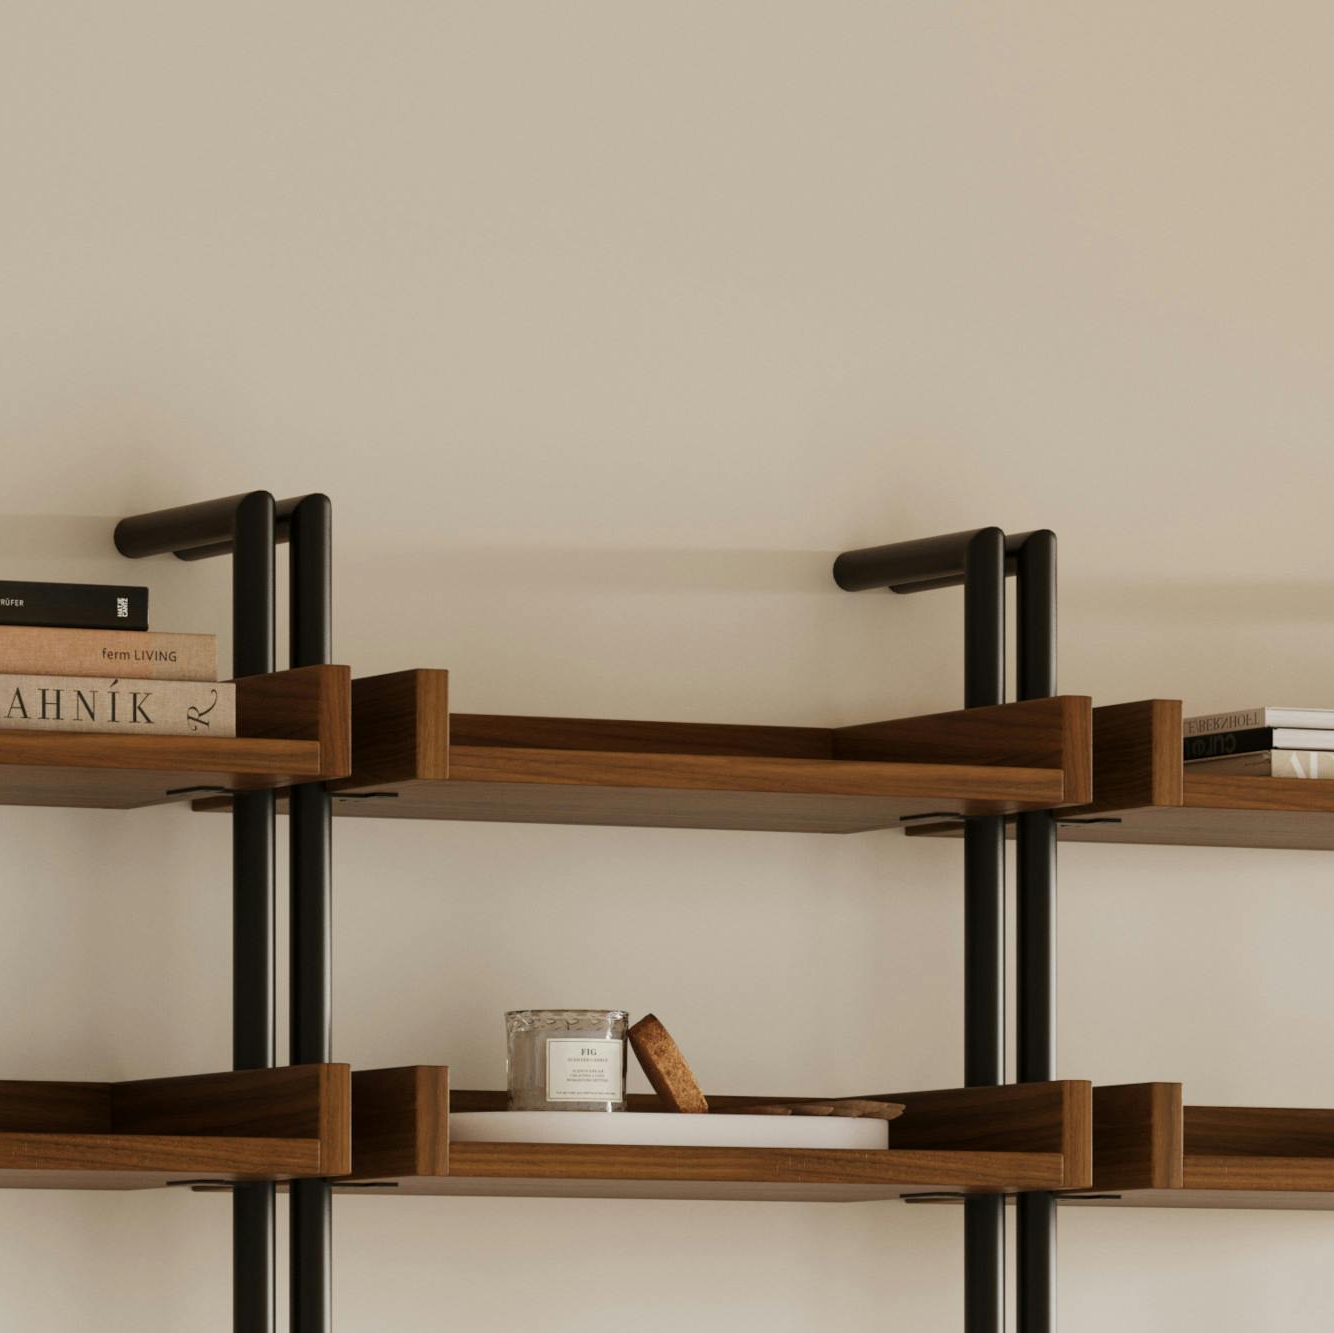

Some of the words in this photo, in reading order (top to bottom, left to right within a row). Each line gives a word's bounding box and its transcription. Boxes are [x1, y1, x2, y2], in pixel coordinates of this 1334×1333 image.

[102, 647, 131, 661] ferm
[134, 649, 178, 663] LIVING
[581, 1048, 598, 1056] FIG
